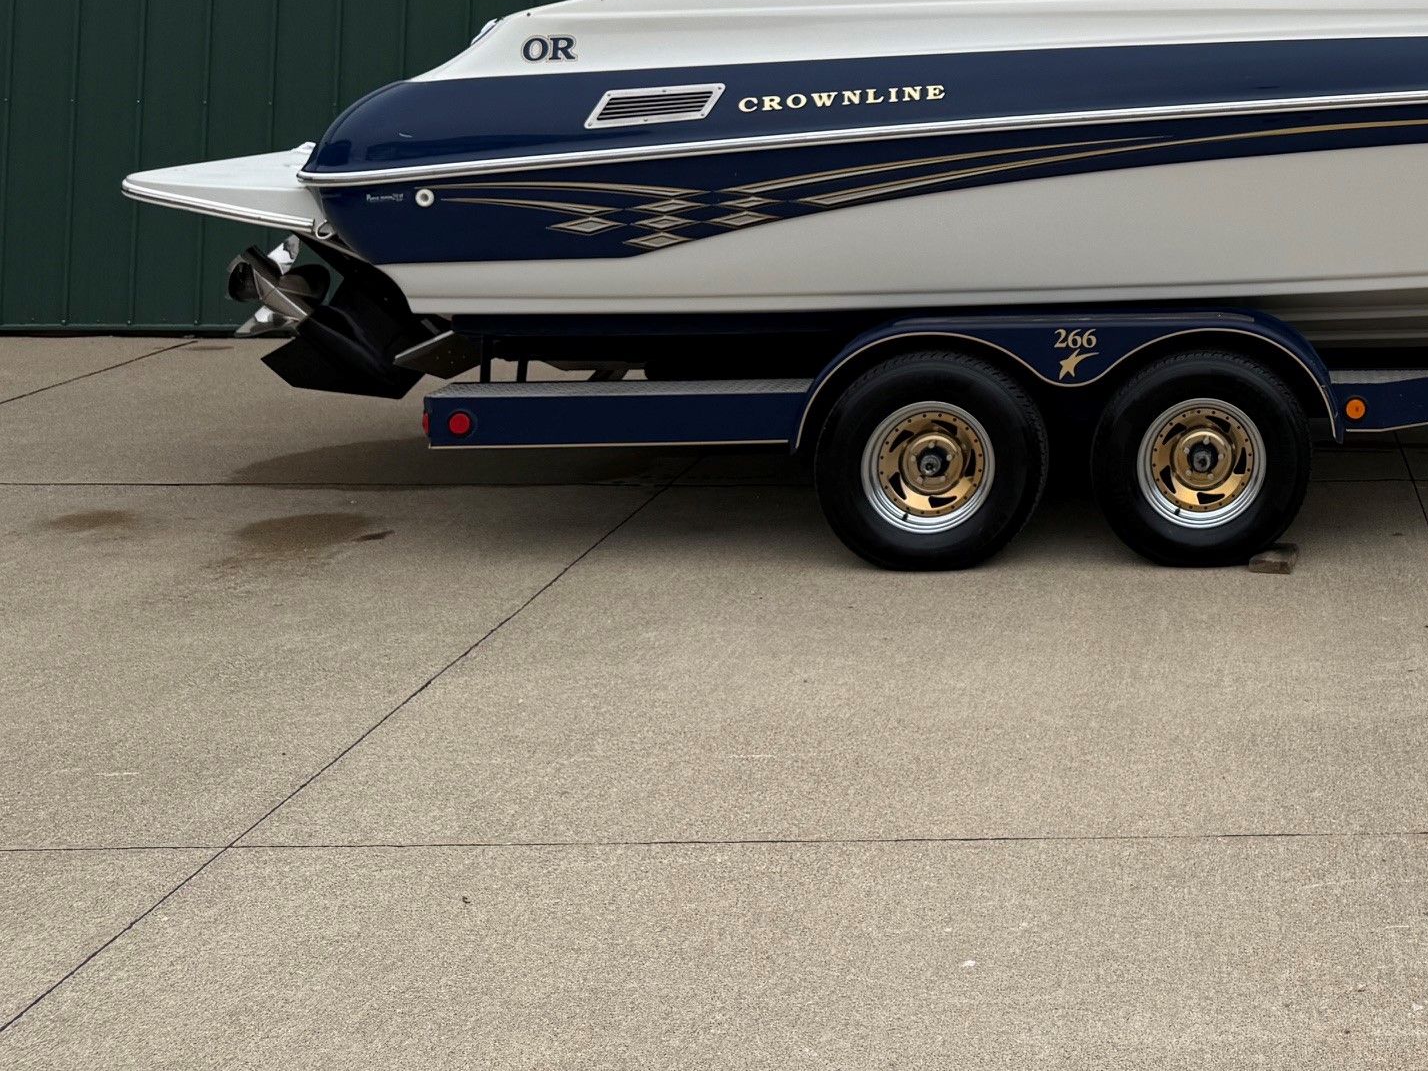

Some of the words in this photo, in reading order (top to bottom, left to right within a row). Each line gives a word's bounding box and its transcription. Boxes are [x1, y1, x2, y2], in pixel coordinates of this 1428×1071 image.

[522, 36, 577, 62] OR
[738, 84, 946, 113] CROWNLINE
[1053, 328, 1098, 349] 266
